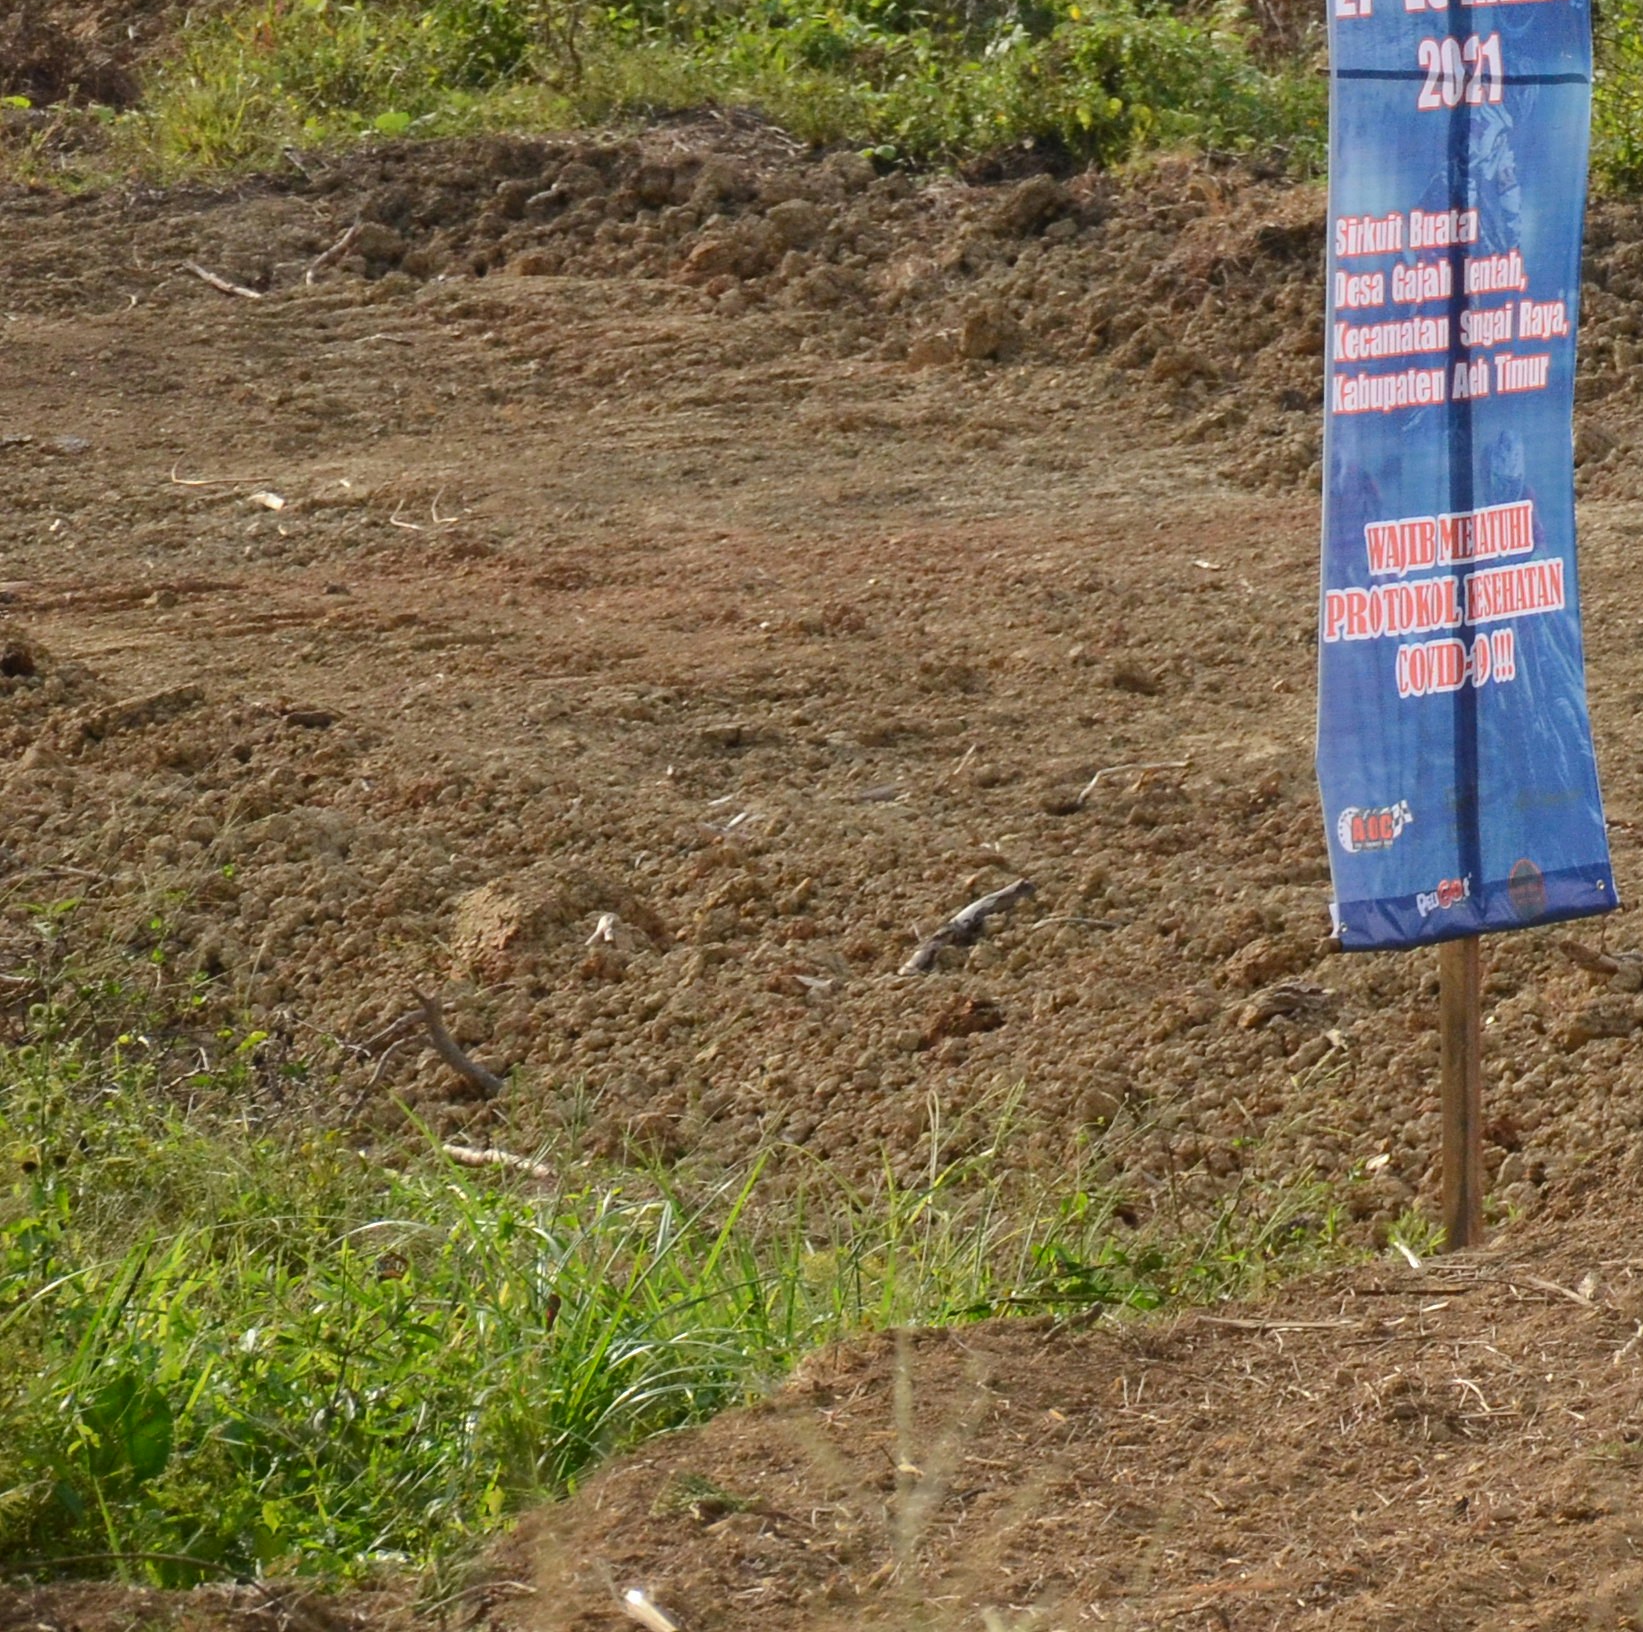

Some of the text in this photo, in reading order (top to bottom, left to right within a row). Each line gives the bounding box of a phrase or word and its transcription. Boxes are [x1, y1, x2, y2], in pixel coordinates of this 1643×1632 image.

[1418, 32, 1503, 110] 2021
[1335, 213, 1403, 256] Sirkuit
[1335, 271, 1384, 308] Desa
[1391, 260, 1452, 303] Gajah
[1333, 318, 1449, 361] Kecamatan
[1519, 302, 1569, 339] Raya,
[1333, 369, 1445, 413] Kabupaten
[1494, 354, 1549, 393] Timur
[1366, 521, 1435, 576] WAJIB
[1325, 579, 1460, 638] PROTOKOL
